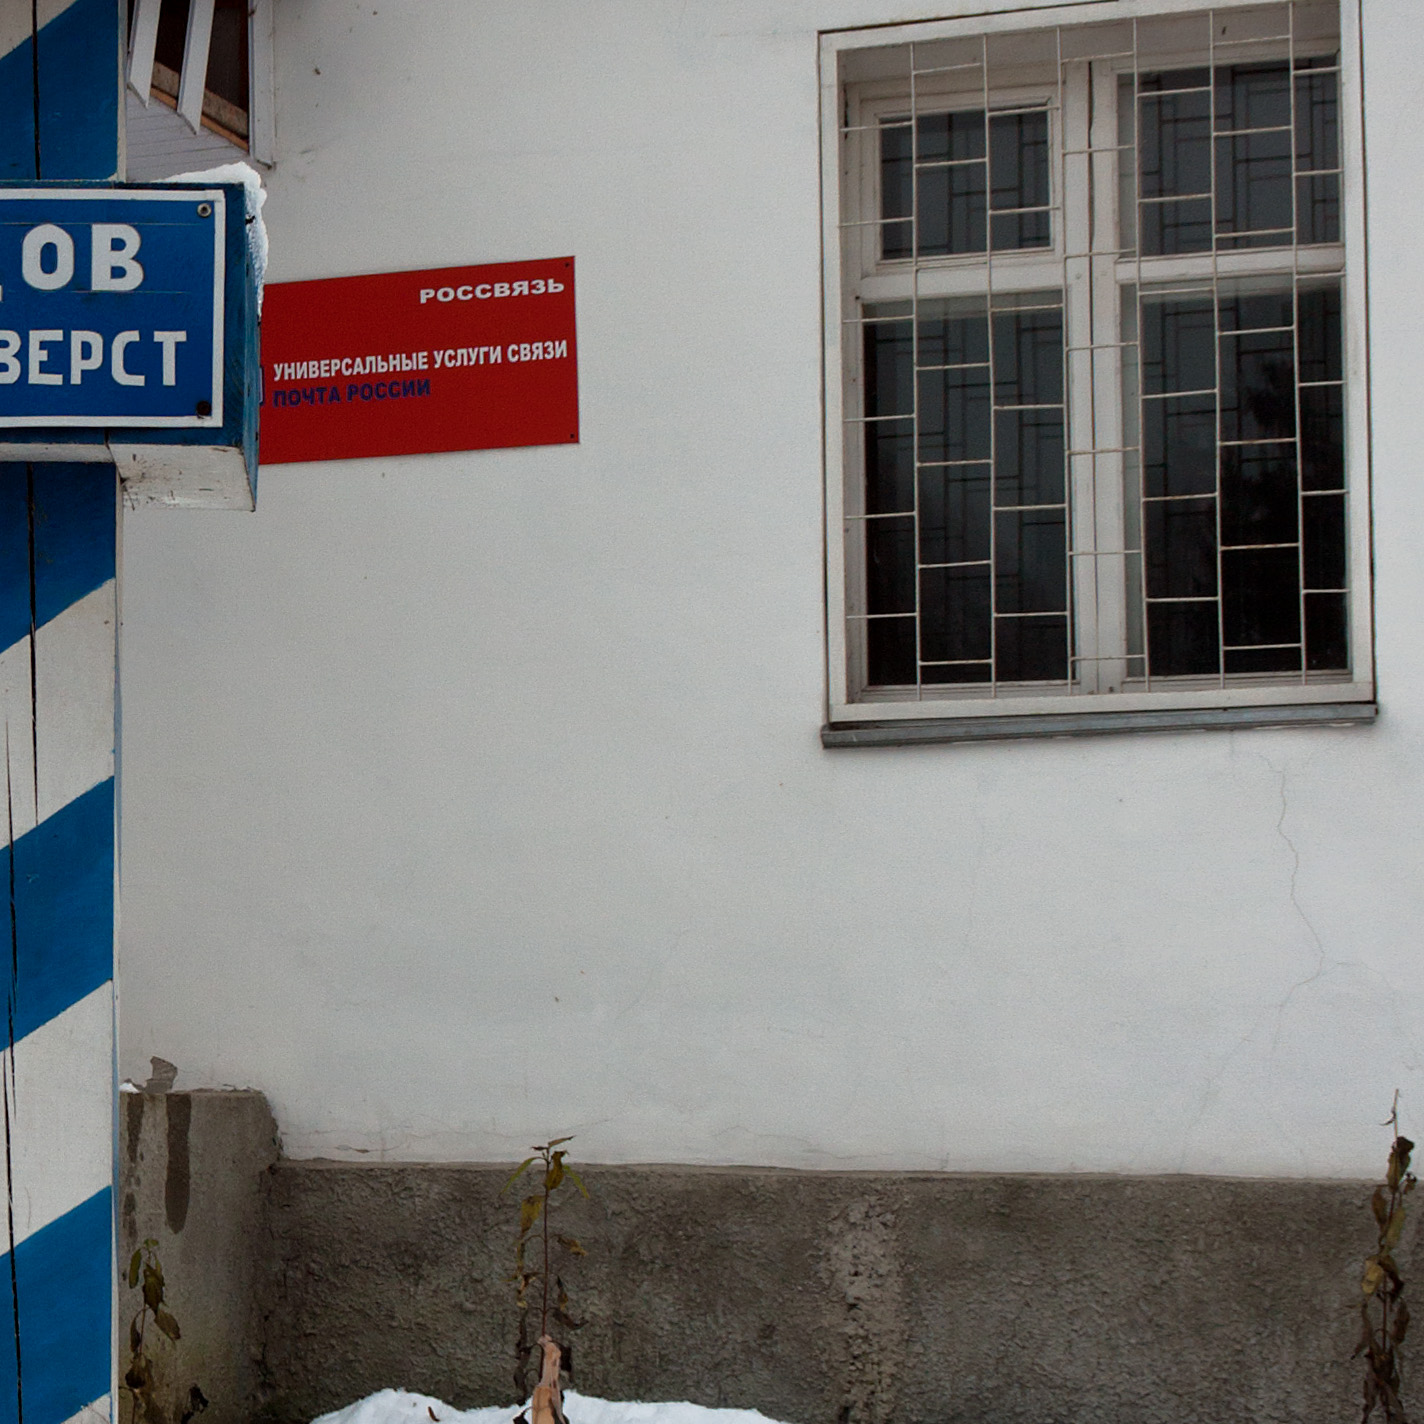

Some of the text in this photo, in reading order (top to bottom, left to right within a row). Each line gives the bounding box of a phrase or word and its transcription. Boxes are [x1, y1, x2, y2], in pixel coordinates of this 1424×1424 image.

[419, 278, 565, 304] РОССВЯЗЬ
[273, 340, 568, 382] УНИВЕРСАЛЬНЫЕ УСЛУГИ СВЯЗИ
[273, 378, 431, 408] ПОЧТА РОССИИ
